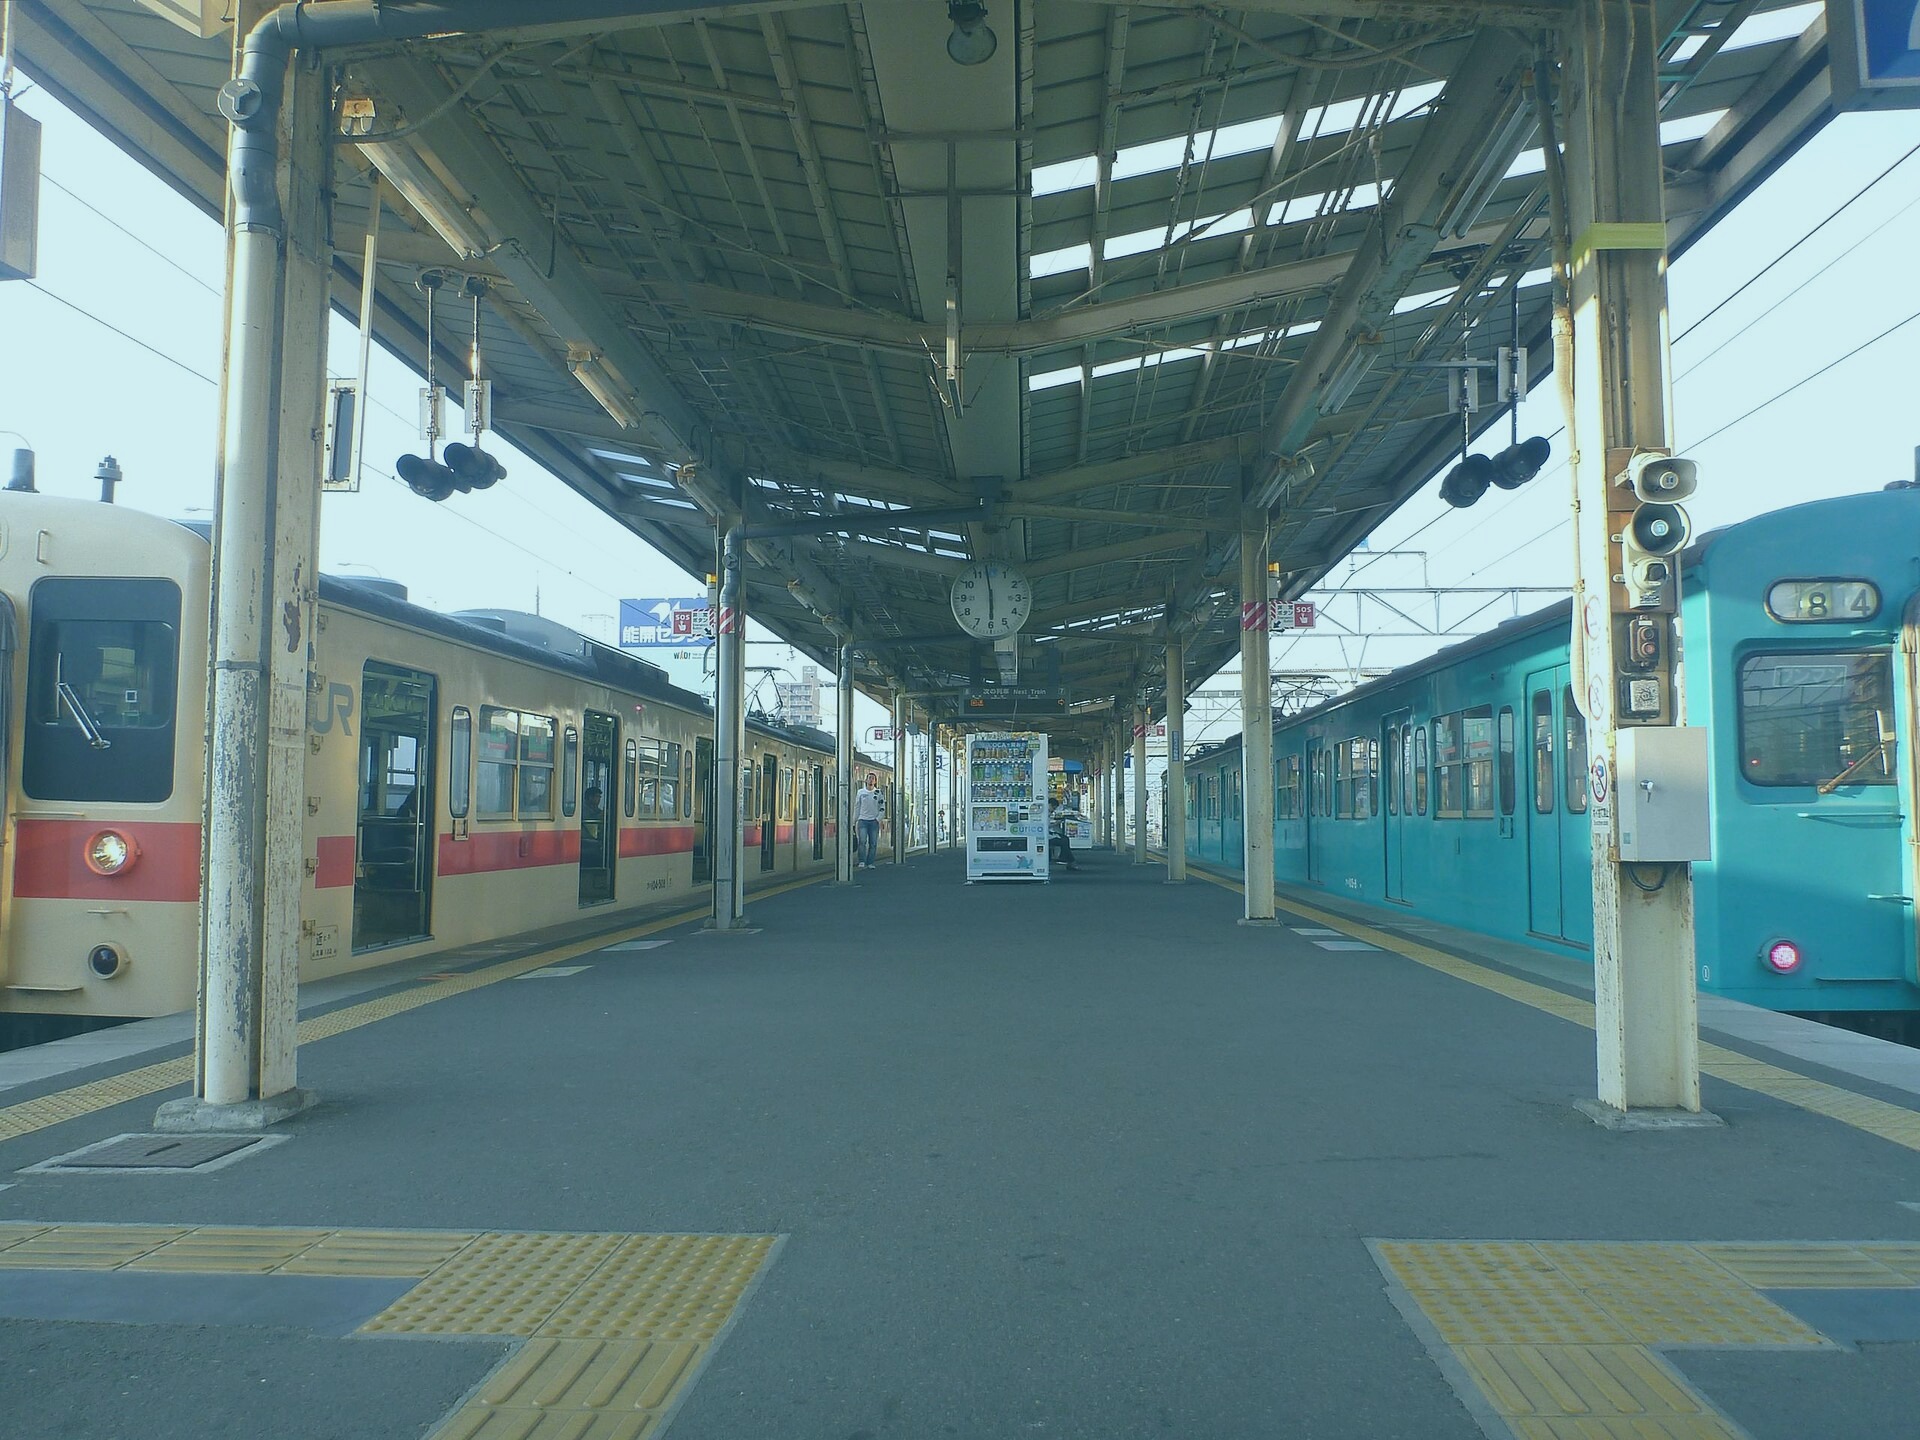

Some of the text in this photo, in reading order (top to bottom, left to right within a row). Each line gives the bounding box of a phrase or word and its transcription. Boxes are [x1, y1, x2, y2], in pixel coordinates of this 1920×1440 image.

[973, 571, 982, 579] 11
[1002, 571, 1007, 579] 1
[964, 581, 974, 589] 10
[1011, 580, 1018, 589] 2
[960, 594, 967, 602] 9
[1015, 594, 1022, 602] 3
[1808, 589, 1870, 618] 8 4
[964, 608, 971, 616] 8
[987, 621, 994, 629] 6
[311, 682, 354, 737] JR
[1010, 824, 1044, 835] curico
